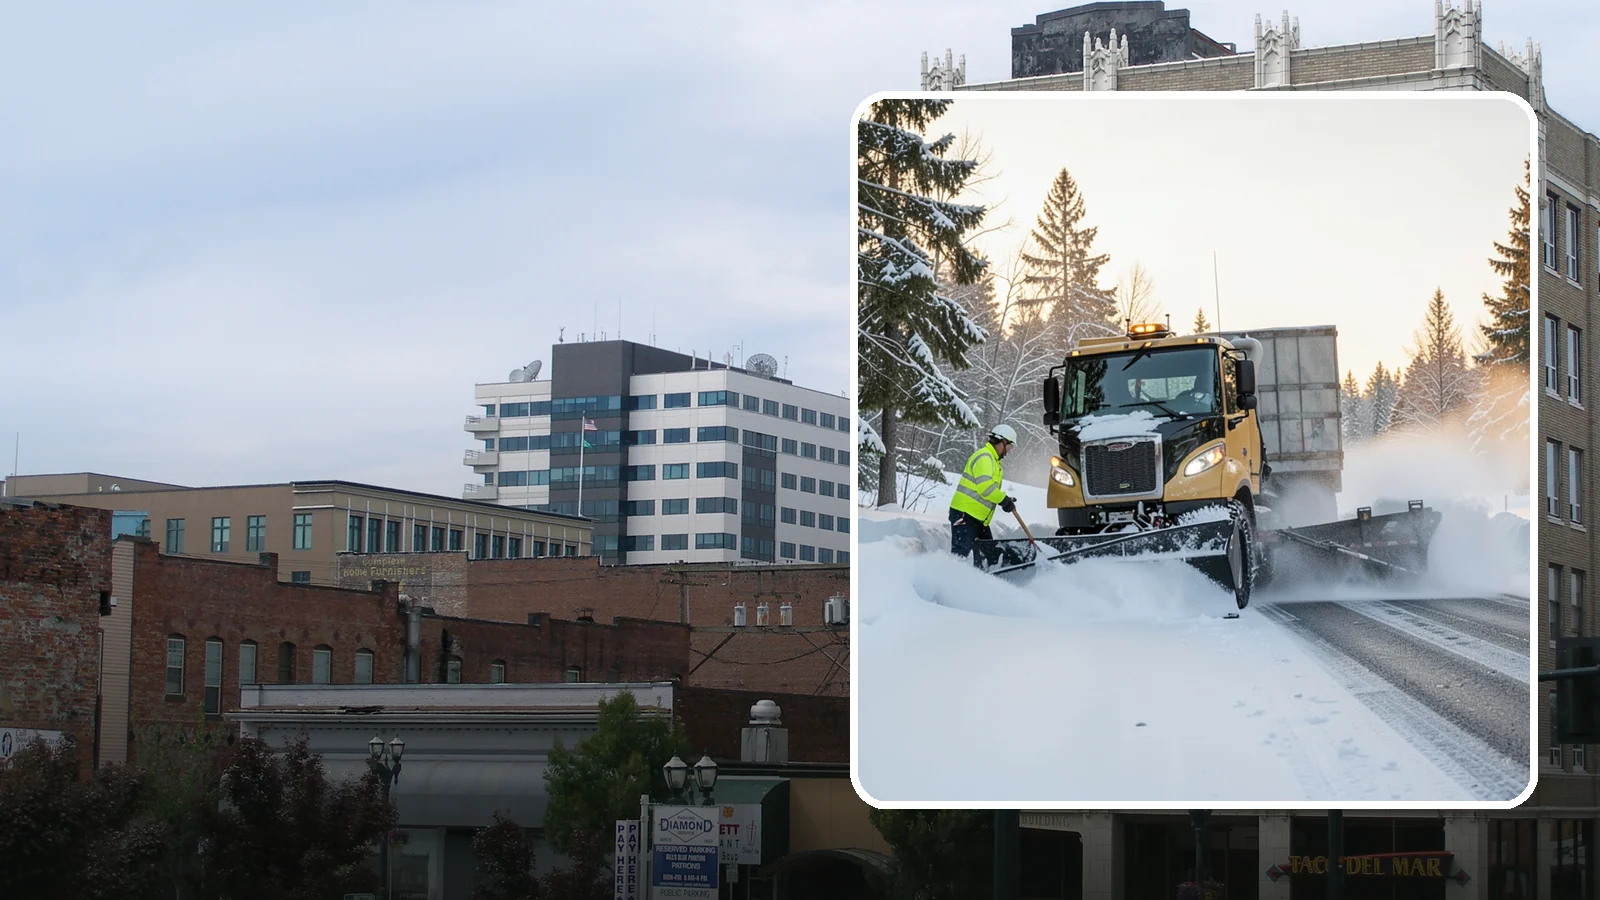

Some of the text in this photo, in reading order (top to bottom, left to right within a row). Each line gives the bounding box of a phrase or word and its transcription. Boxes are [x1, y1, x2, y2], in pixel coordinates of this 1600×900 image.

[370, 566, 427, 577] Furnishers
[660, 818, 713, 833] DIAMOND
[1023, 816, 1069, 827] BUILDING
[689, 846, 716, 854] PARKING
[616, 825, 625, 894] PAY HERE
[627, 824, 637, 893] PAY HERE
[1347, 856, 1385, 876] DEL
[1392, 857, 1442, 877] MAR
[660, 889, 710, 898] PUBLIC PARKING
